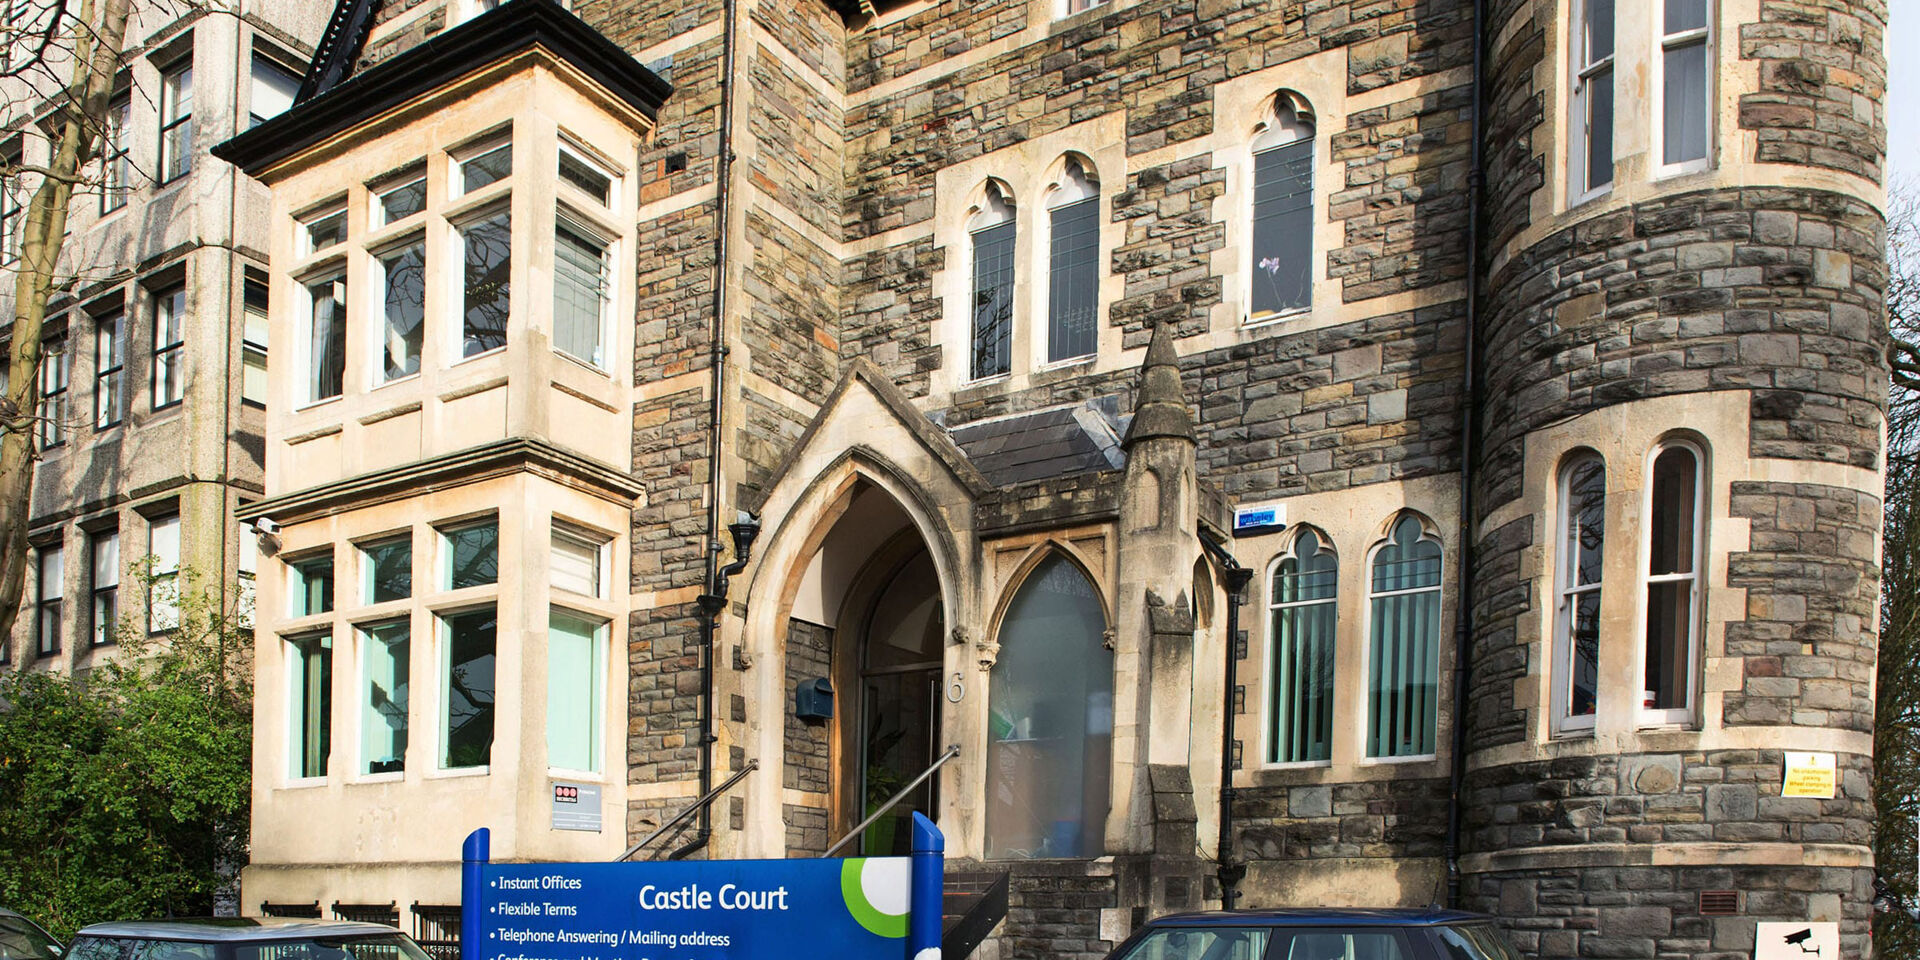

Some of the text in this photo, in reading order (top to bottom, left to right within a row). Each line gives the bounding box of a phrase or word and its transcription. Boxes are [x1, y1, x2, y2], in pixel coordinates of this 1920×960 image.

[947, 671, 965, 703] 6
[499, 875, 582, 890] Instant Offices
[639, 884, 789, 910] Castle Court
[498, 902, 577, 916] Flexible Terms
[498, 928, 731, 949] Telephone Answering / Mailing address
